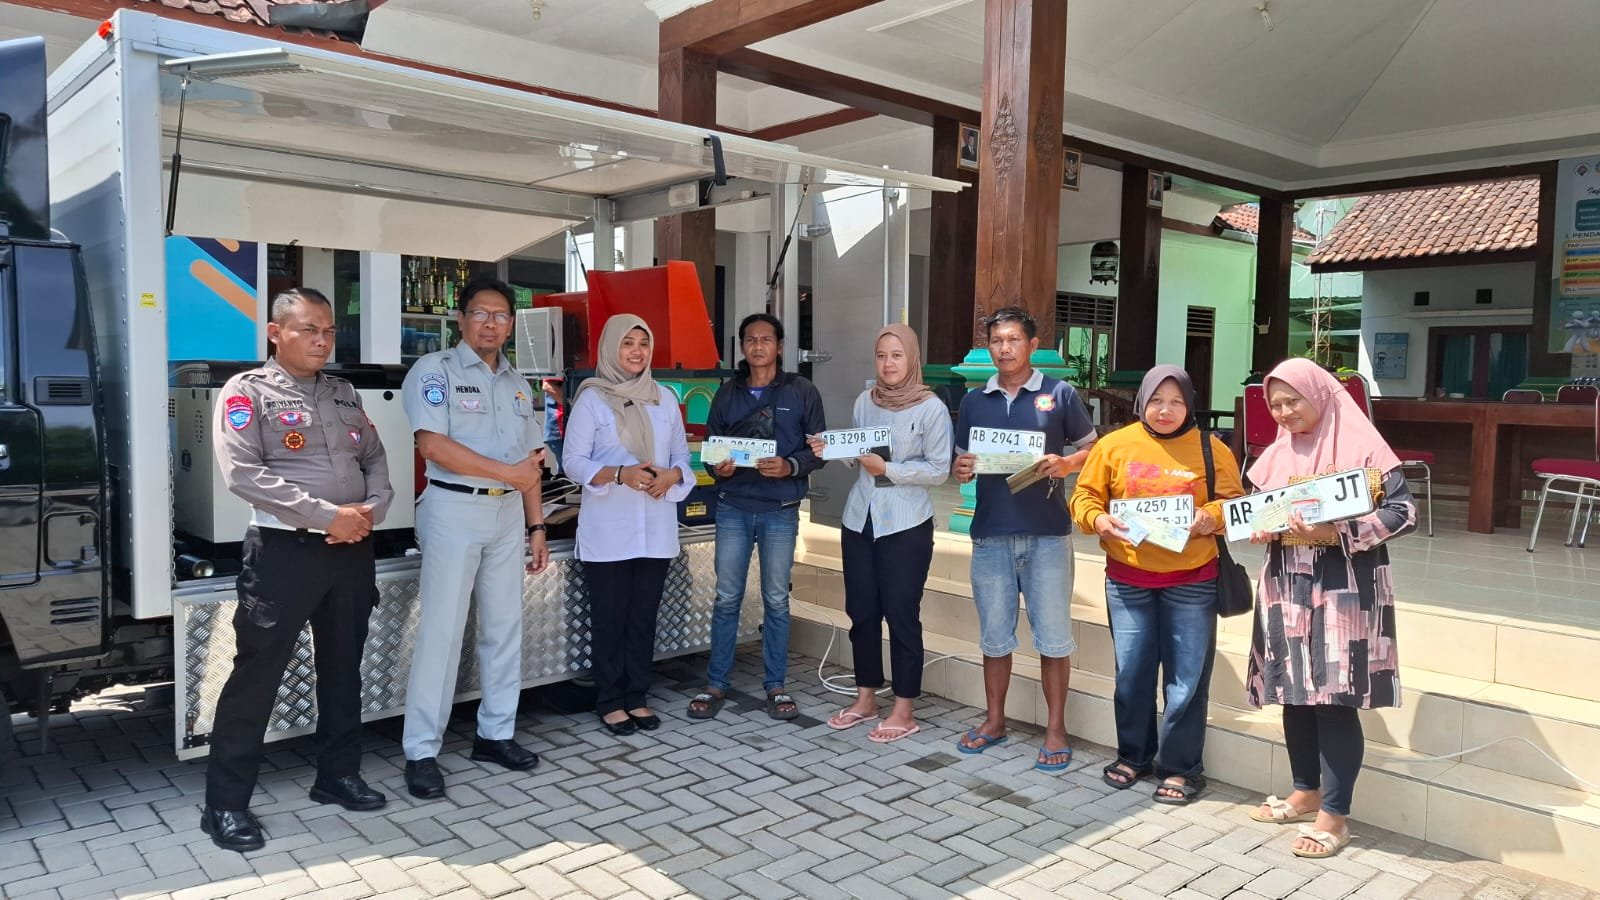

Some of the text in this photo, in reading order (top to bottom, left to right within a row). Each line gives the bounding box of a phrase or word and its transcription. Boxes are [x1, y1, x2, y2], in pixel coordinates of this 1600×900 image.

[455, 385, 481, 394] HENDRA
[840, 431, 867, 445] 3298
[874, 430, 887, 442] GP
[971, 429, 1043, 448] AB 2941 AG
[1334, 473, 1360, 502] JT
[1136, 499, 1167, 513] 4259
[1175, 497, 1190, 511] IK
